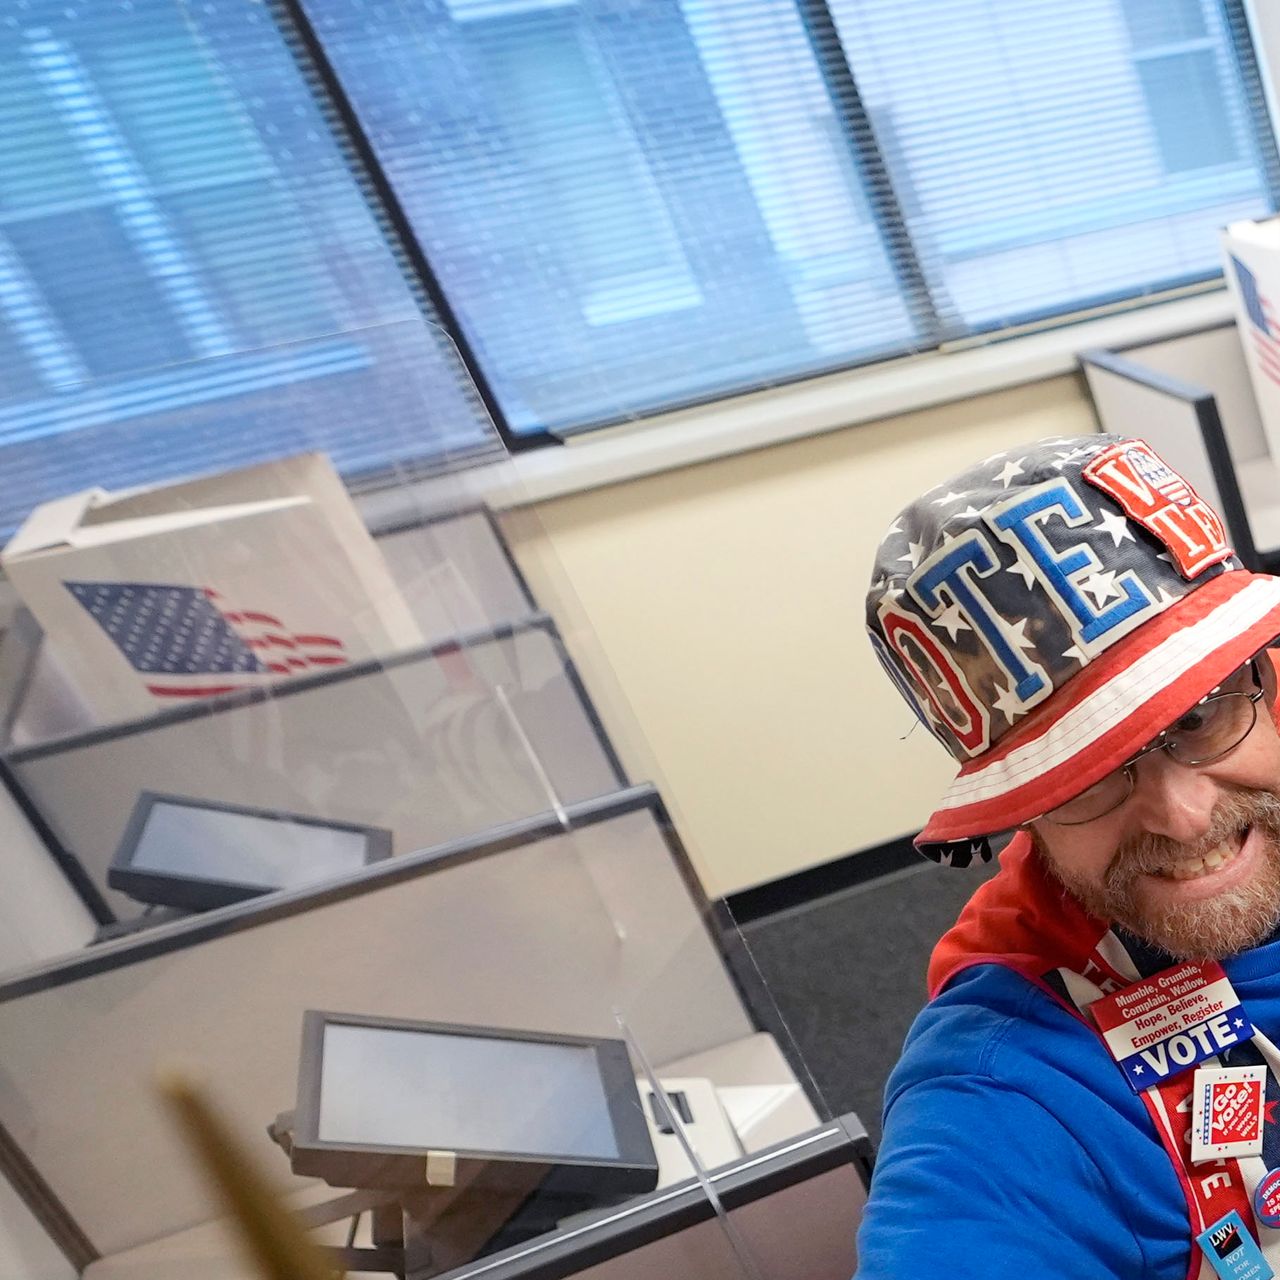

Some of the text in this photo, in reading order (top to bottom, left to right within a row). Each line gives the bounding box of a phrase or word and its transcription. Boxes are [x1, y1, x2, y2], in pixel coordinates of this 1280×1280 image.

[1115, 965, 1201, 1008] Mumble, Grumble,
[1121, 975, 1208, 1020] Complain, Wallow,
[1130, 999, 1224, 1049] Empower, Register
[1134, 993, 1208, 1031] Hope, Believe,
[1139, 1013, 1239, 1077] VOTE
[1266, 1197, 1275, 1207] IS
[1208, 1221, 1234, 1248] LWV
[1225, 1248, 1245, 1267] NOT
[1233, 1259, 1250, 1275] FOR
